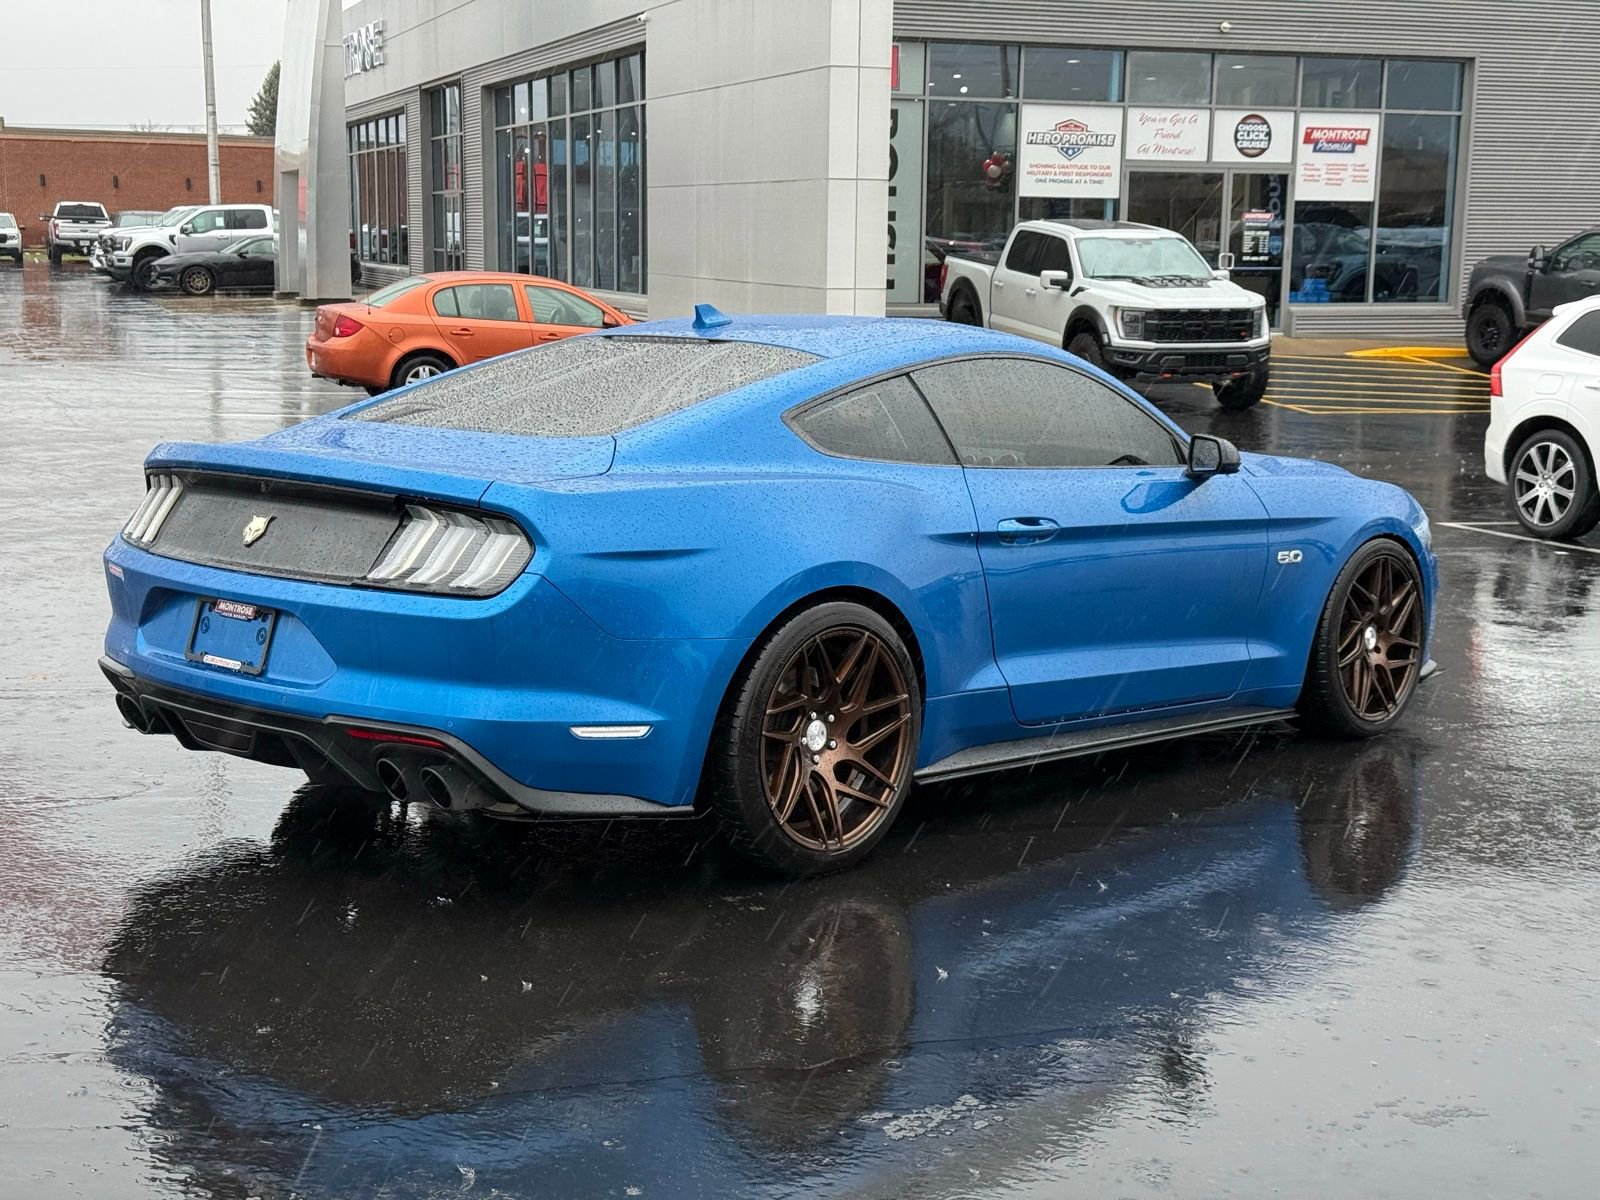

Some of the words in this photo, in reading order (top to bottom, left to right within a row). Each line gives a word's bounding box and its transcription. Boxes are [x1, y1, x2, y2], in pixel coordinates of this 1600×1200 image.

[1169, 113, 1187, 126] Got
[1027, 132, 1061, 145] HERO
[1061, 133, 1116, 147] PROMISE
[1237, 131, 1269, 140] CLICK.
[1311, 129, 1369, 140] MONTROSE
[1316, 140, 1353, 151] Promise
[218, 601, 254, 616] MONTROSE
